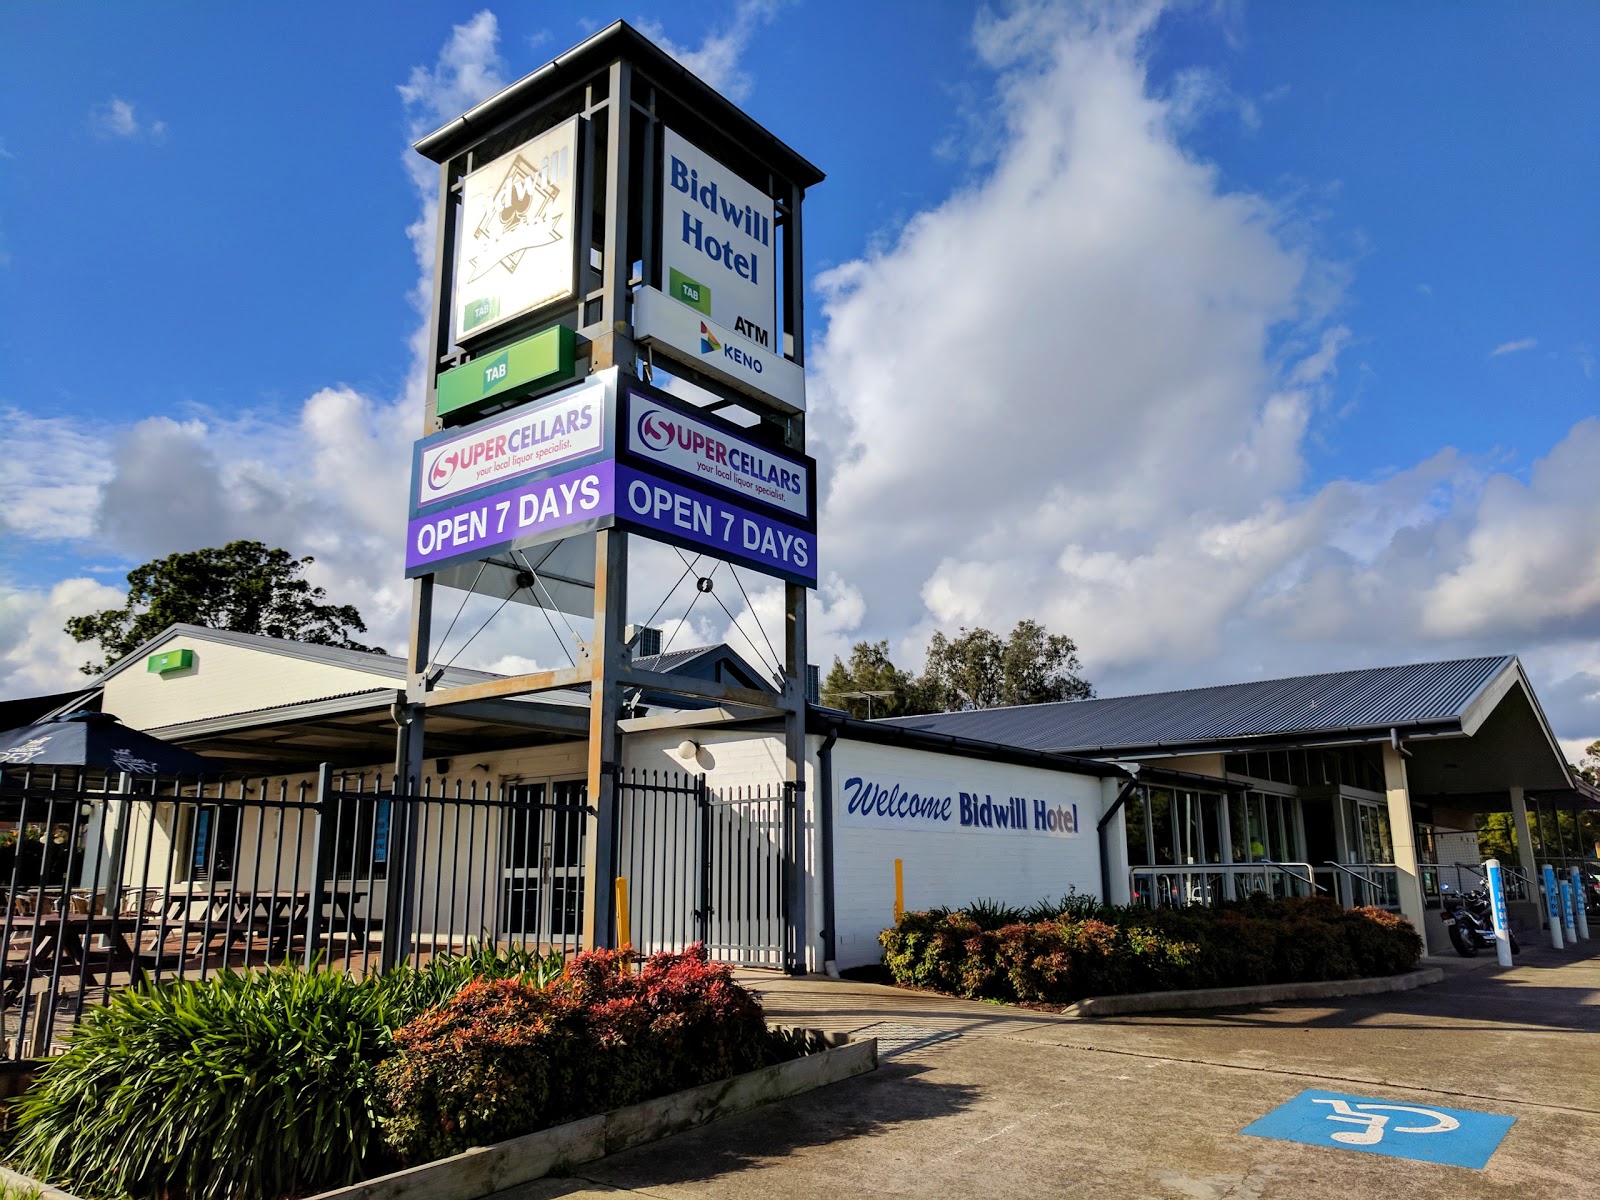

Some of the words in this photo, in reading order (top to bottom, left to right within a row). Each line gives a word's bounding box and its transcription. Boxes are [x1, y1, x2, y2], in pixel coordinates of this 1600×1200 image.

[472, 146, 568, 216] idwill
[670, 154, 769, 247] Bidwill
[682, 210, 758, 285] Hotel
[475, 304, 489, 318] TAB
[682, 284, 699, 301] TAB
[734, 316, 768, 347] ATM
[485, 363, 506, 383] TAB
[724, 342, 763, 374] KENO
[476, 465, 492, 480] your
[493, 456, 510, 472] local
[512, 452, 533, 470] liquor
[535, 439, 572, 461] specialist.
[696, 460, 714, 474] your
[715, 465, 732, 481] local
[733, 473, 753, 490] liquor
[755, 484, 786, 502] specialist.
[417, 506, 487, 555] OPEN
[495, 501, 510, 533] 7
[518, 474, 600, 528] DAYS
[628, 479, 712, 537] OPEN
[720, 512, 735, 542] 7
[743, 518, 809, 568] DAYS
[844, 777, 952, 822] Welcome
[958, 791, 1028, 830] Bidwill
[1033, 799, 1079, 834] Hotel
